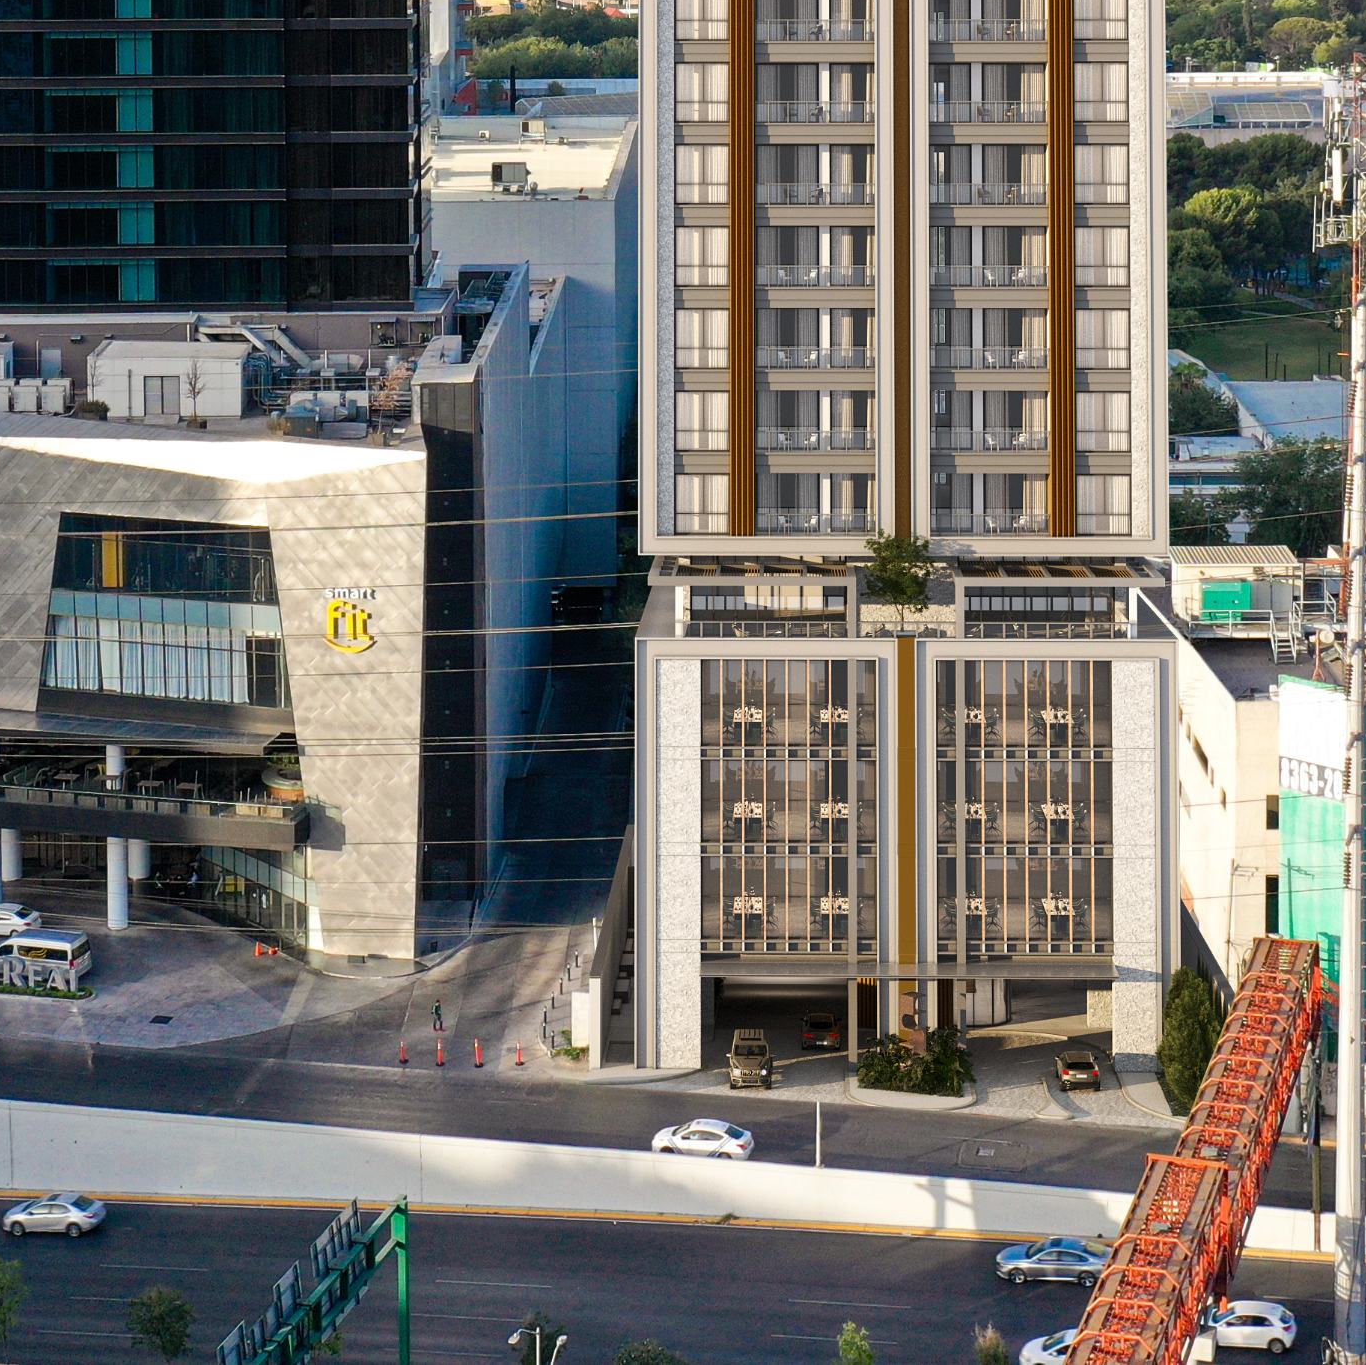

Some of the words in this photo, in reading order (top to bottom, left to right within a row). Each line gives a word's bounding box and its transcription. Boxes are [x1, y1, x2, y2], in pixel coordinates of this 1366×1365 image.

[325, 587, 375, 600] smart
[327, 599, 373, 642] fit
[1280, 757, 1344, 802] 8363-20
